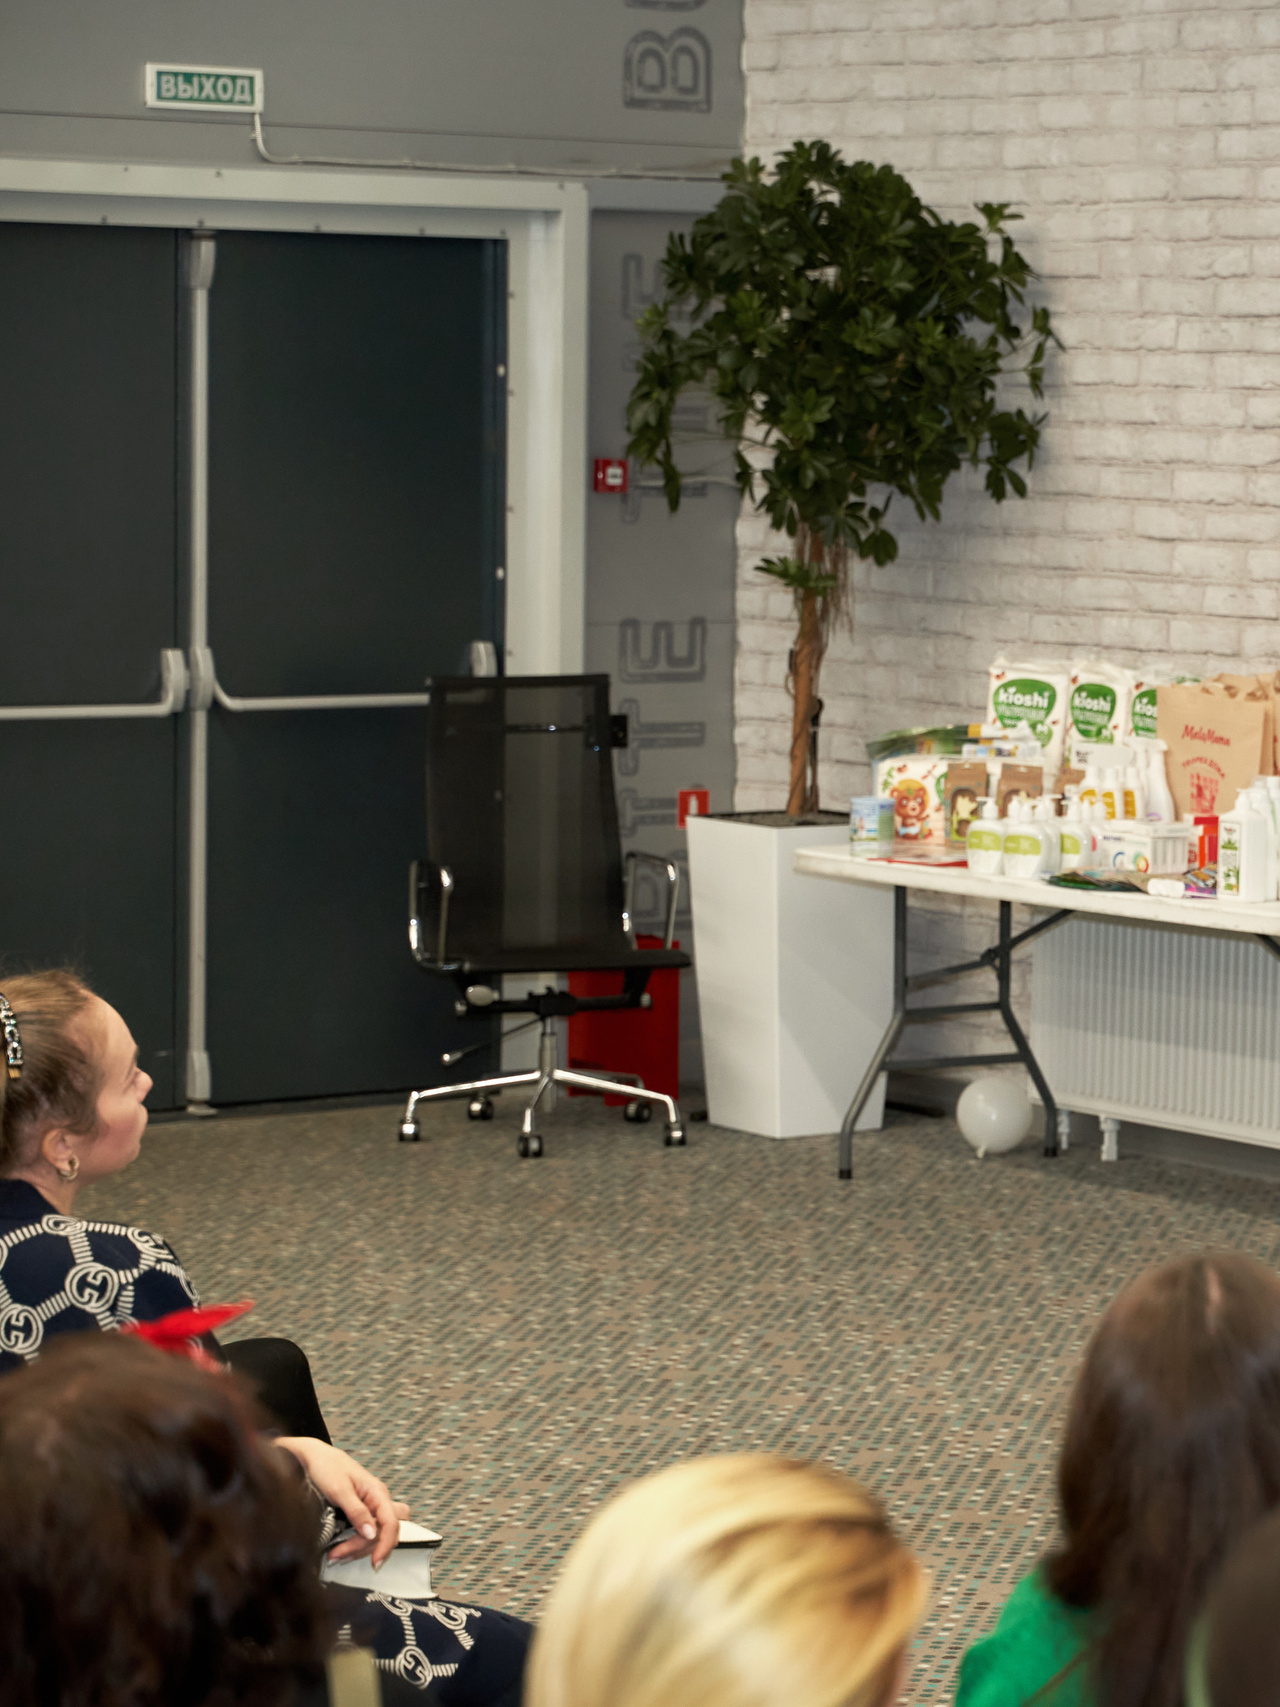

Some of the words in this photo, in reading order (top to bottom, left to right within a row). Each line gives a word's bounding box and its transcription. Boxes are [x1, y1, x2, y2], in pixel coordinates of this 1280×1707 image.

[160, 74, 252, 102] ВЫХОД
[998, 687, 1050, 709] kioshi
[1073, 692, 1112, 713] kioshi
